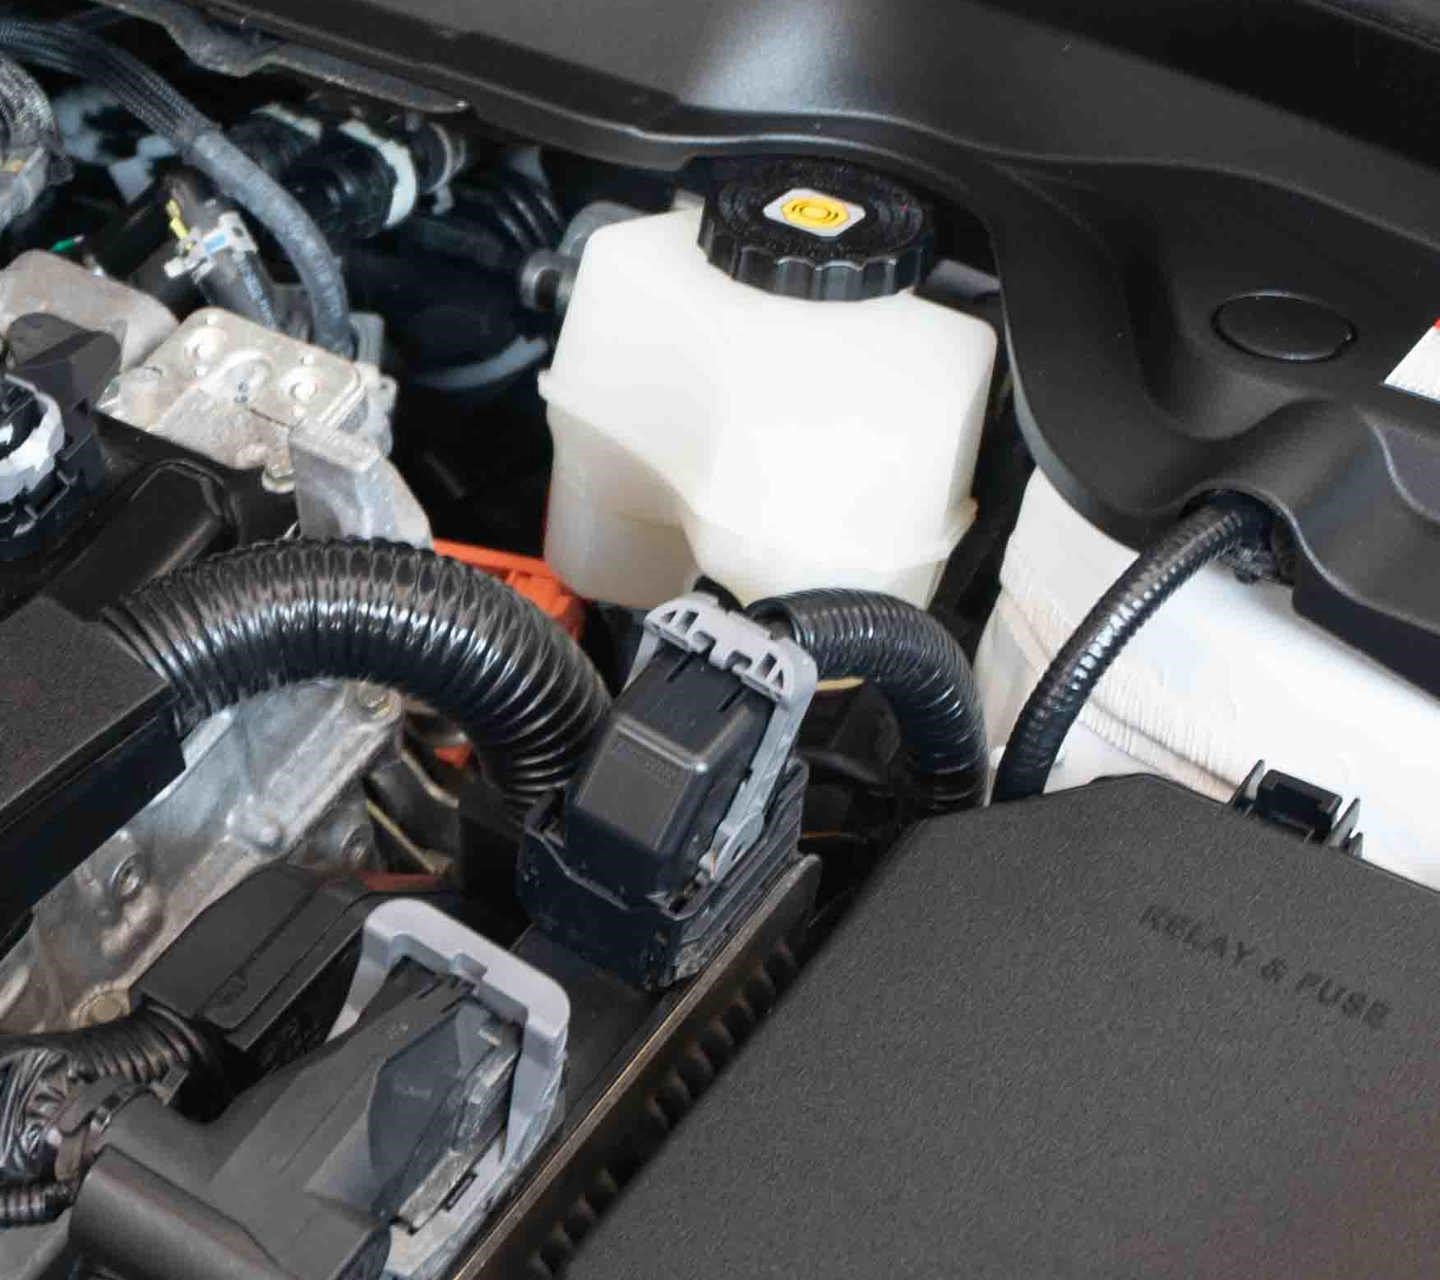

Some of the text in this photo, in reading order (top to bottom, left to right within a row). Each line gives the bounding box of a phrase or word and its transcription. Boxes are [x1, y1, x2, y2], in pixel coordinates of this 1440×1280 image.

[1140, 906, 1392, 1029] RELAY & FUSE
